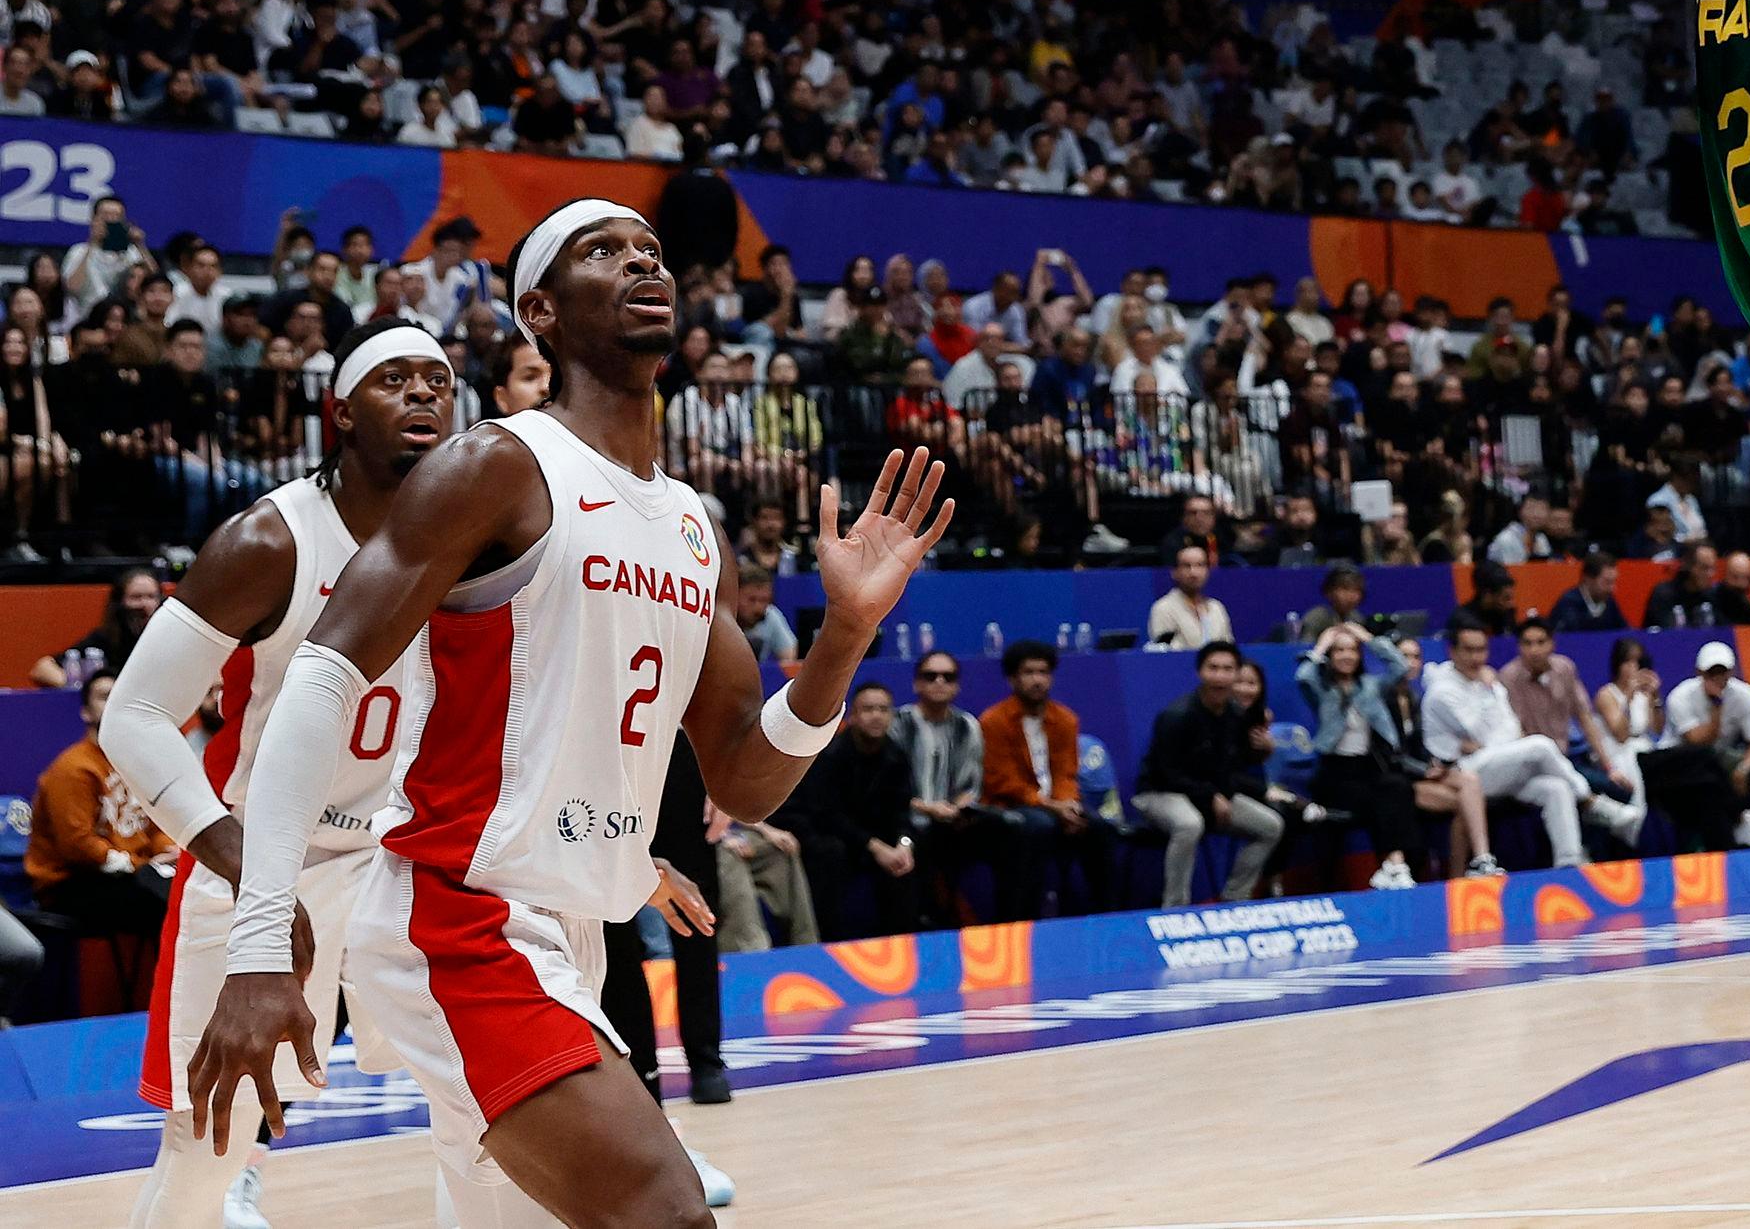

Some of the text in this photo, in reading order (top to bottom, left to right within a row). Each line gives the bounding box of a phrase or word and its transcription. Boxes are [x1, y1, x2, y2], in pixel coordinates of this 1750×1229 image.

[0, 139, 116, 225] 23
[582, 555, 711, 624] CANADA
[349, 686, 401, 760] 0
[621, 645, 663, 746] 2
